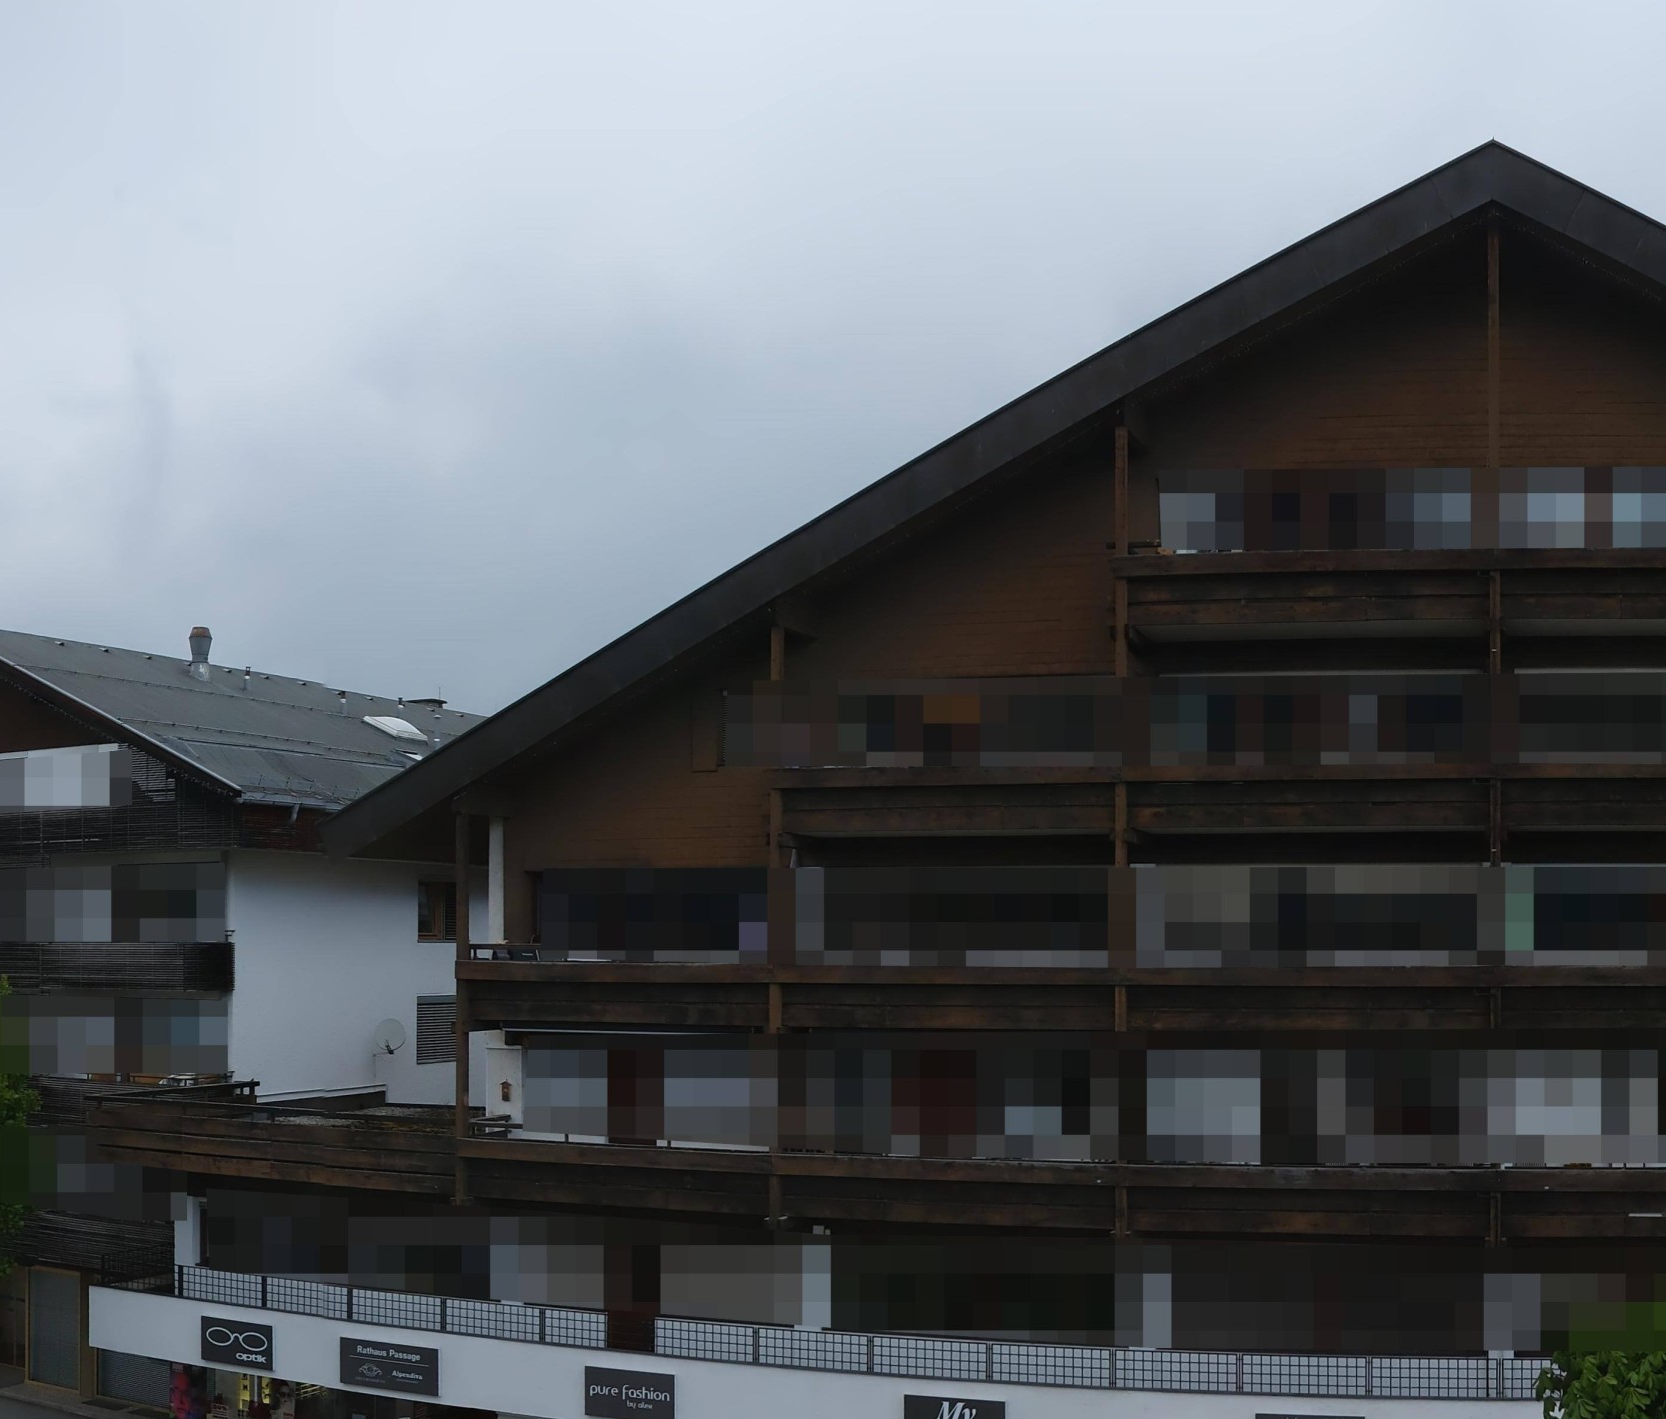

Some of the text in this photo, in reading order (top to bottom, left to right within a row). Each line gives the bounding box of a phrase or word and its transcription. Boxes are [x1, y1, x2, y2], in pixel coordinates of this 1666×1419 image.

[236, 1352, 267, 1364] optik
[357, 1345, 421, 1361] Rathaus Passage
[589, 1384, 670, 1401] pure fashion
[626, 1400, 636, 1409] by
